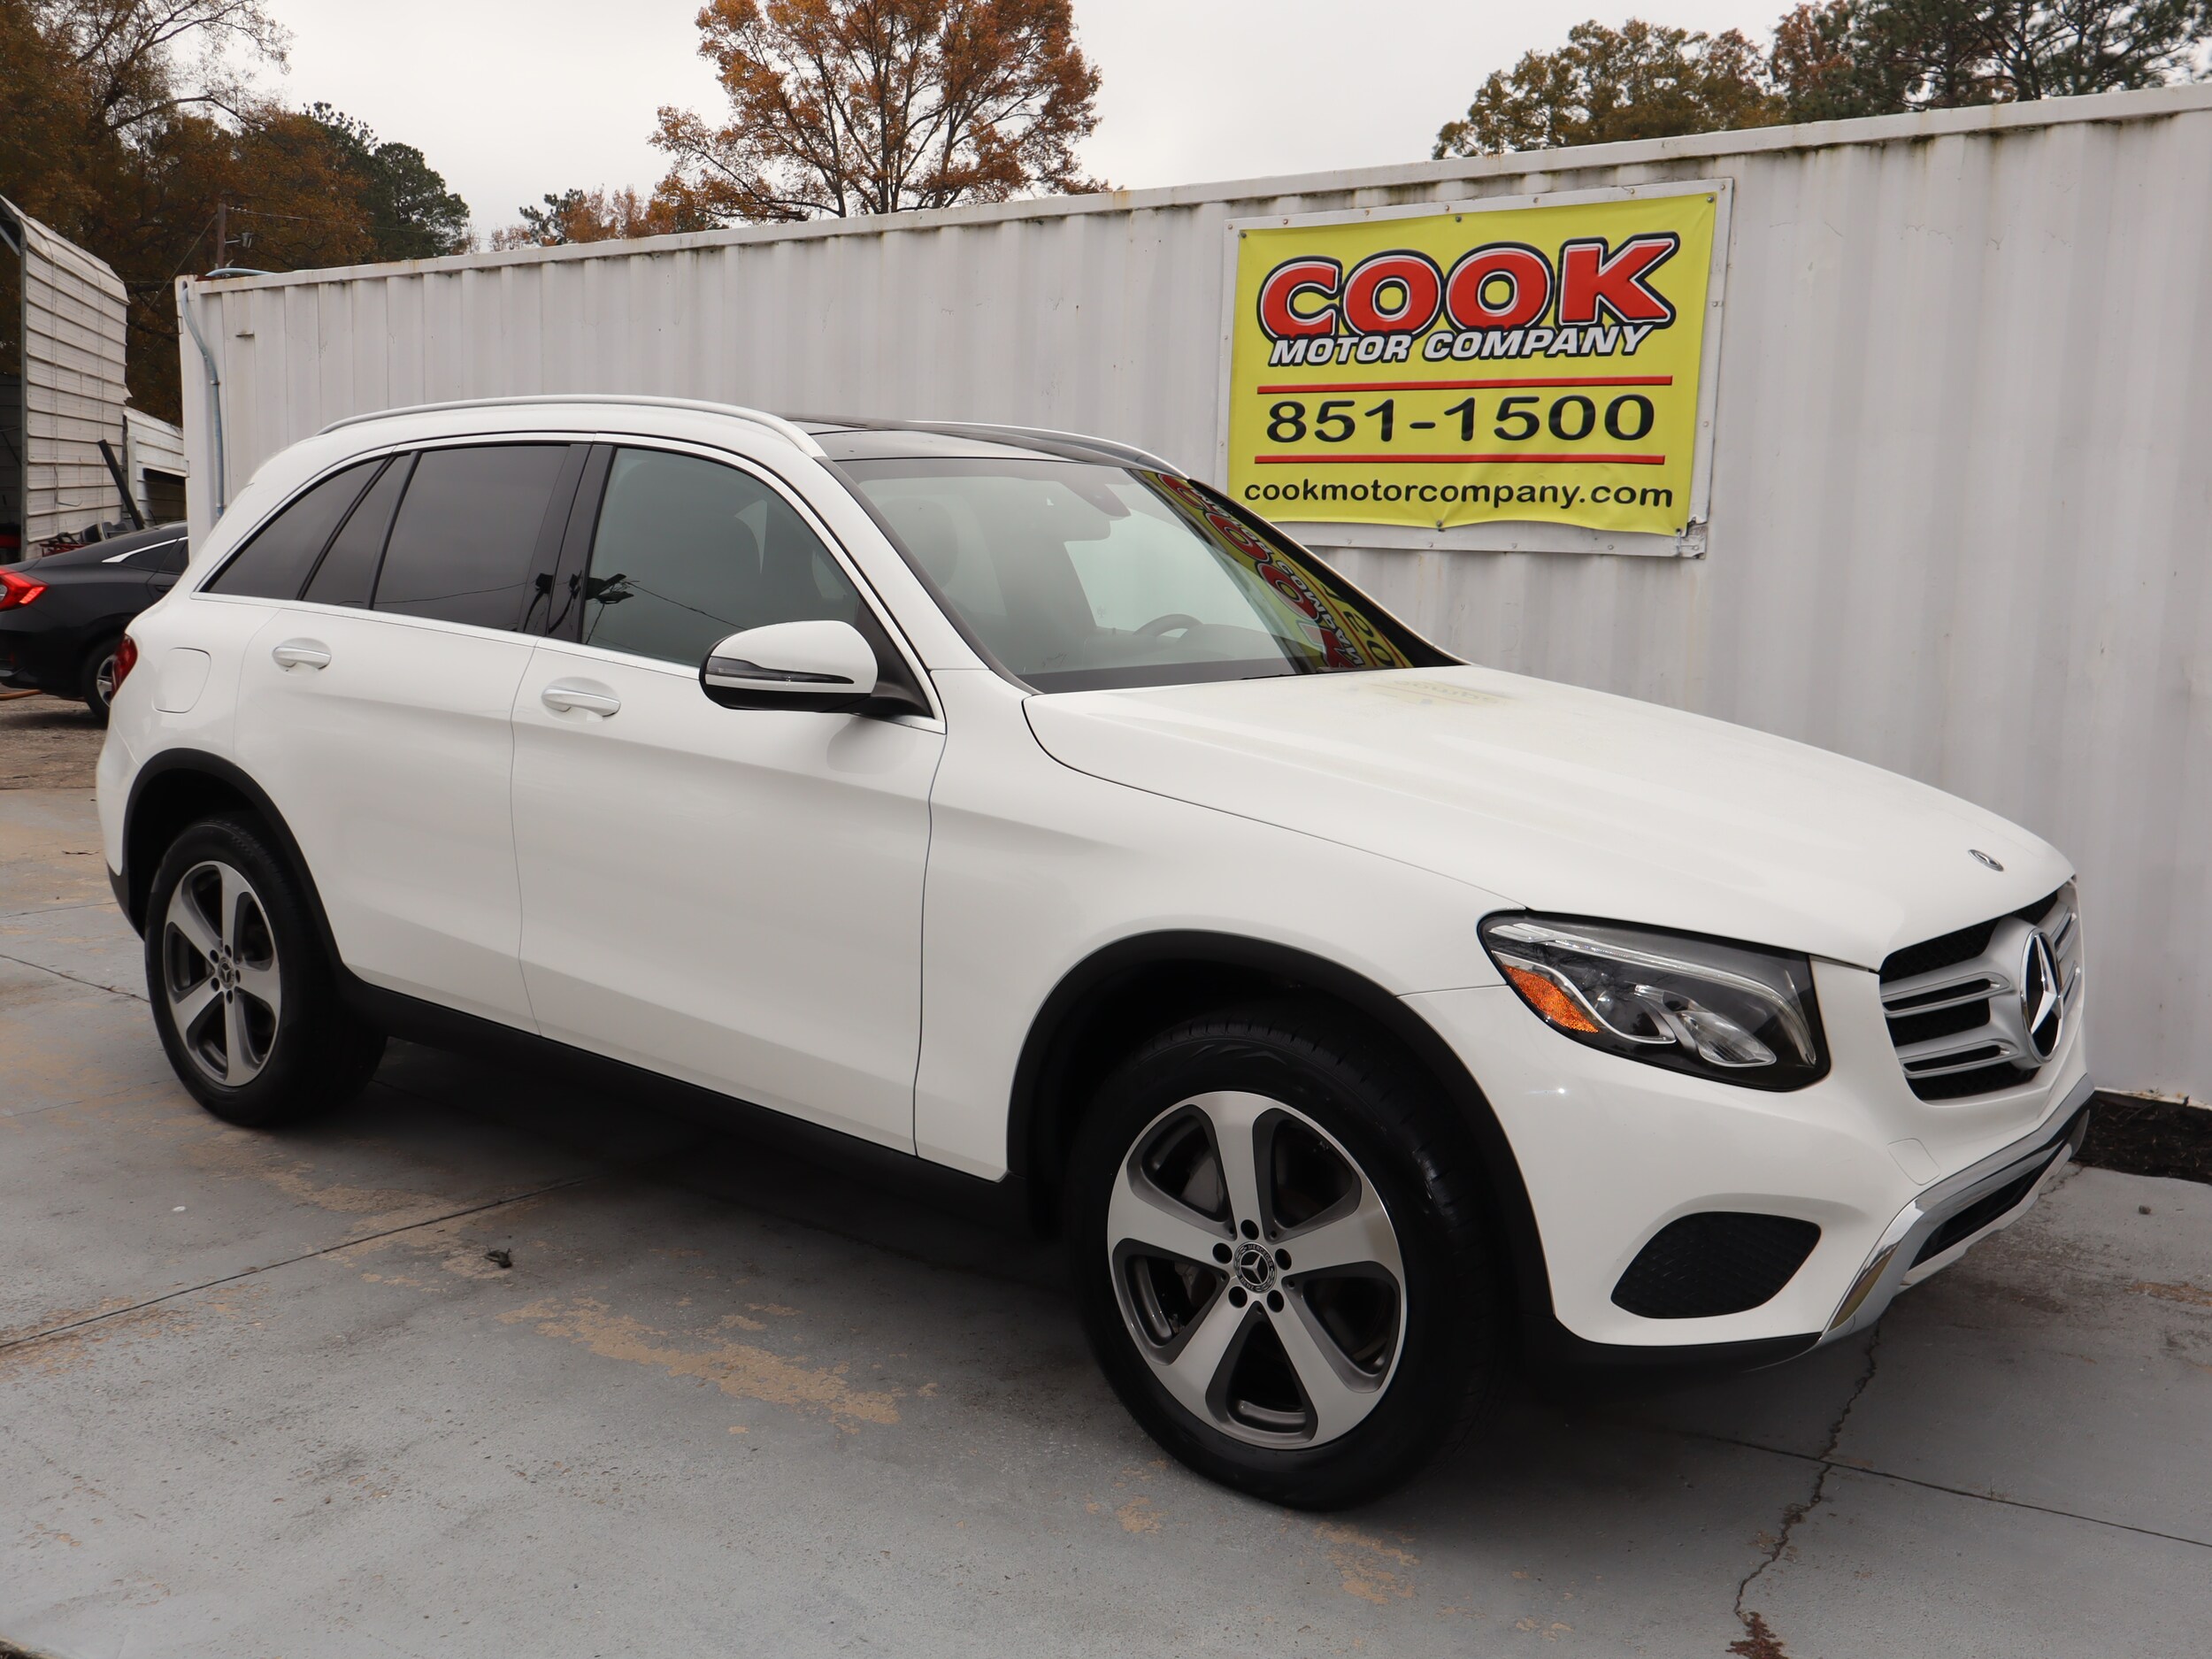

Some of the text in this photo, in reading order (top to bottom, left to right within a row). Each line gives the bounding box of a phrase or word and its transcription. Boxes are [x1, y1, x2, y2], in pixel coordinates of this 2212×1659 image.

[1258, 233, 1679, 340] COOK
[1269, 325, 1653, 366] MOTOR COMPANY
[1266, 395, 1655, 442] 851-1500
[1244, 480, 1673, 510] cookmotorcompany.com
